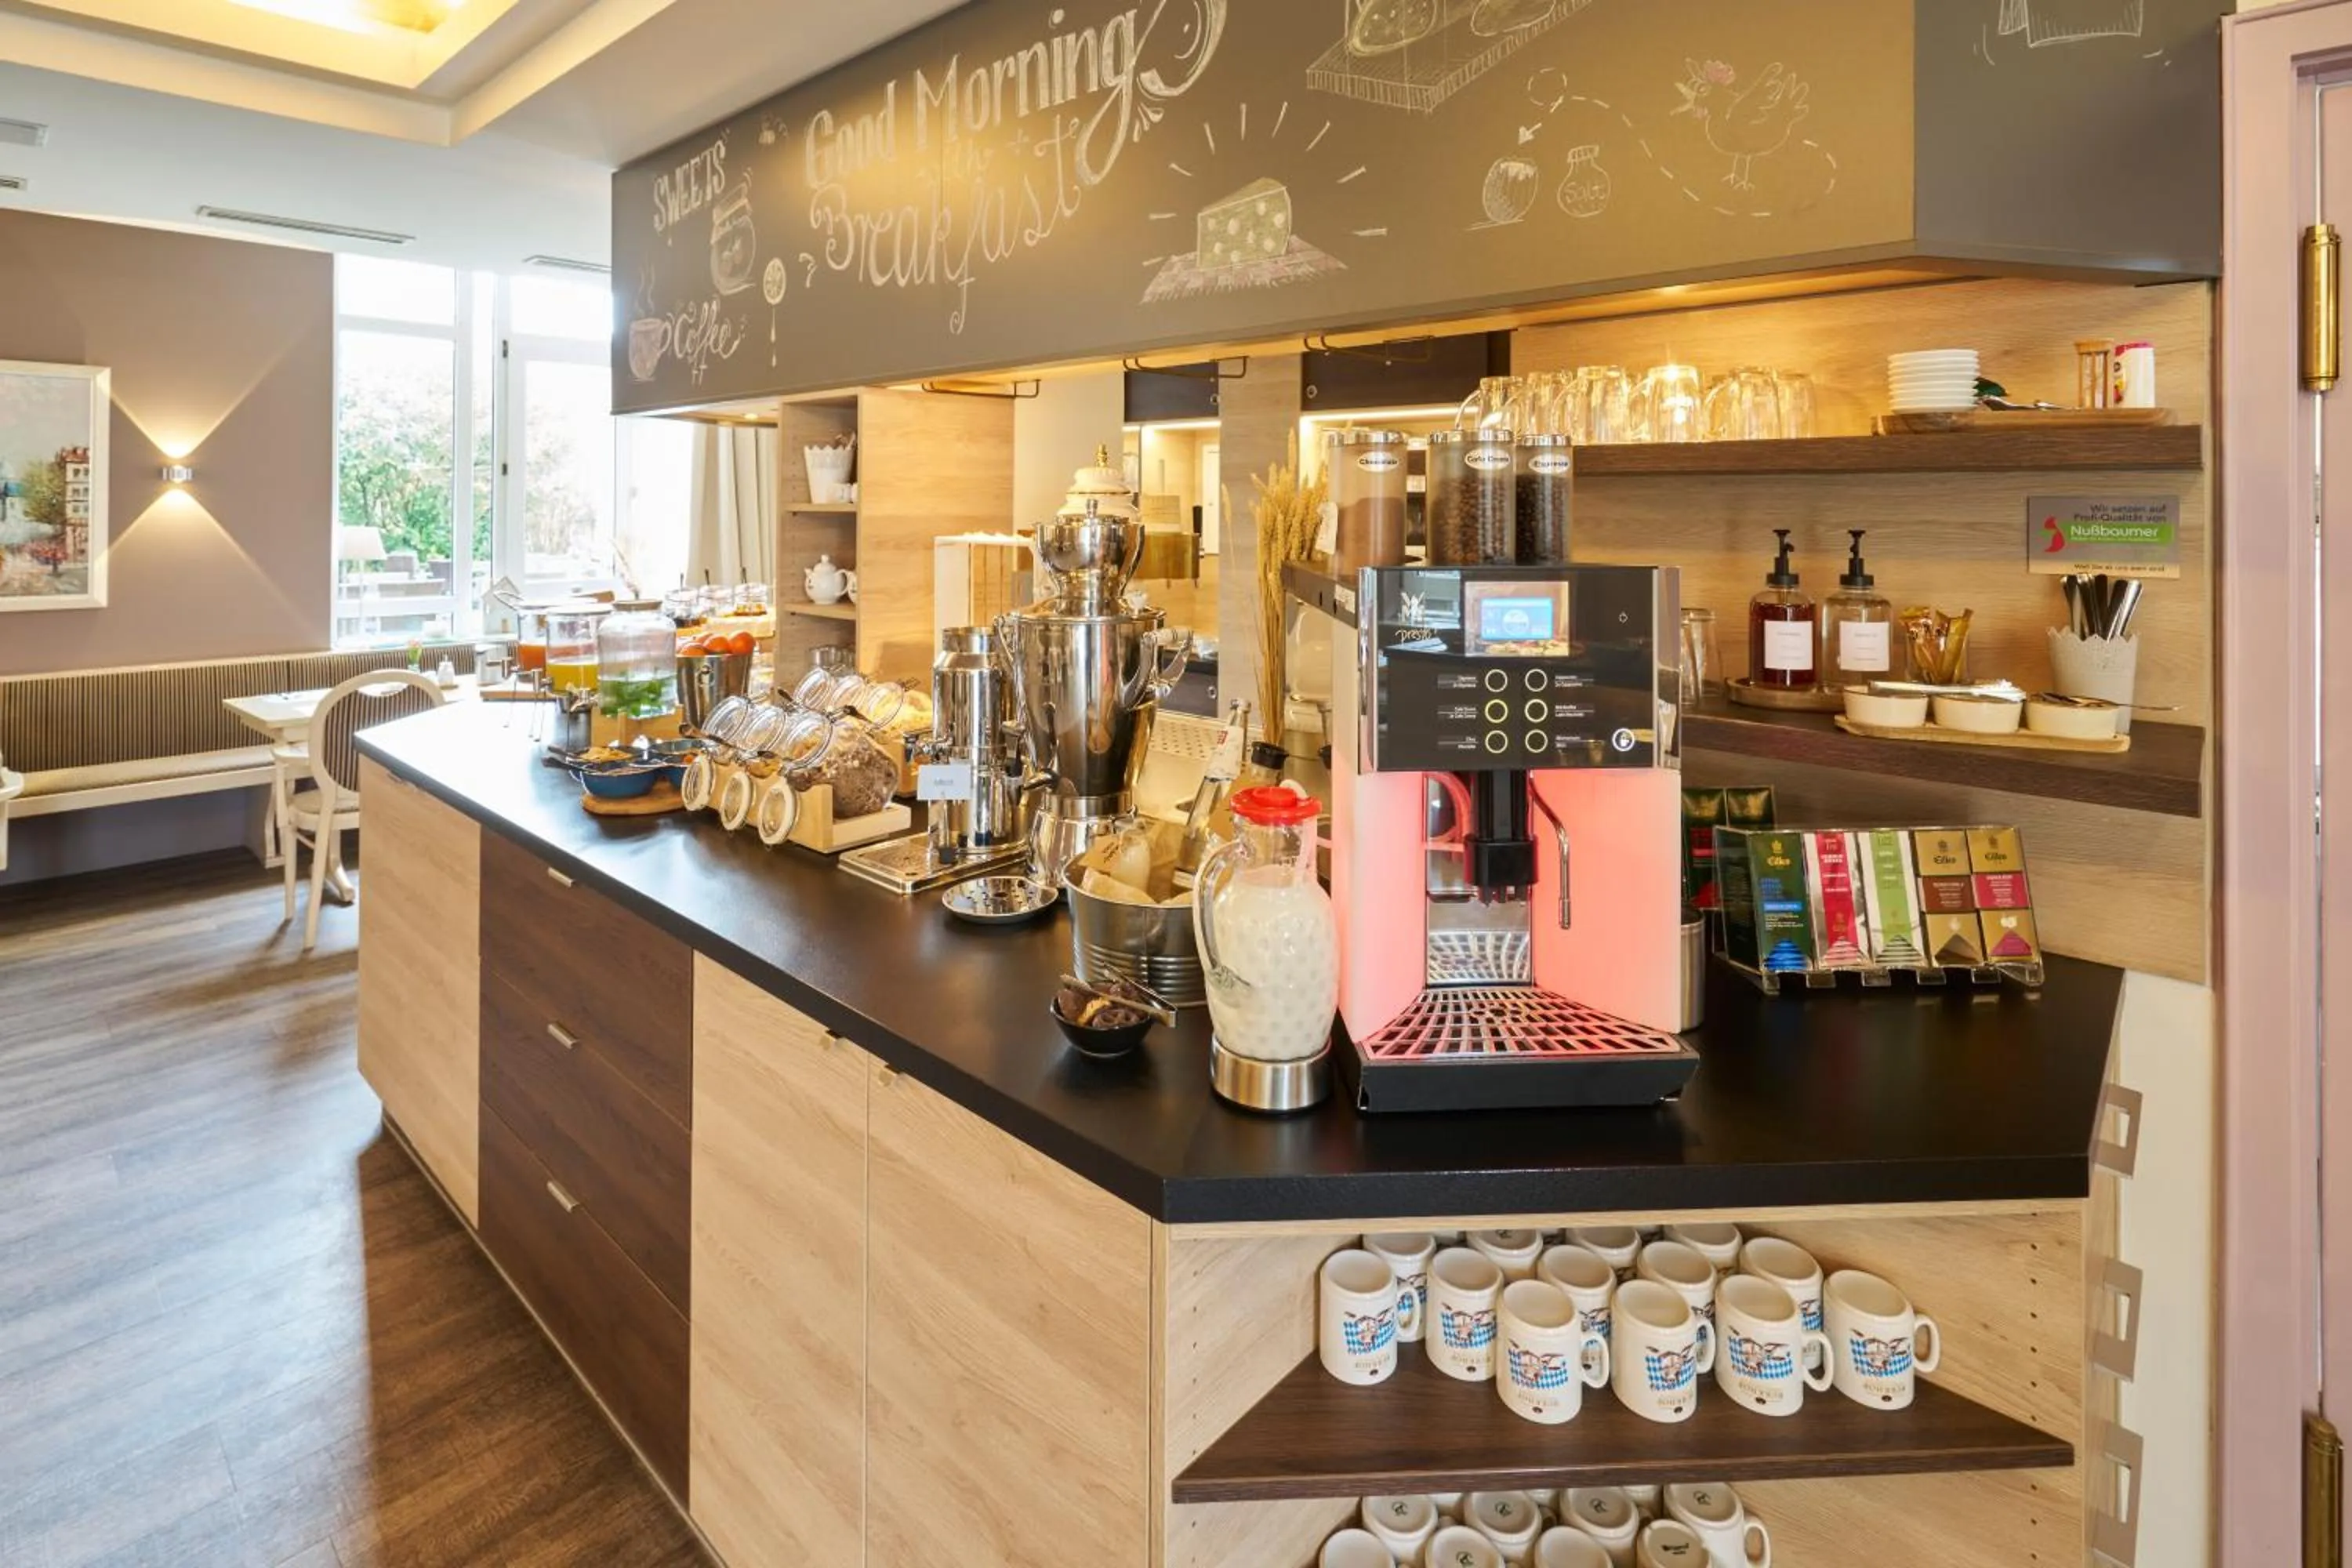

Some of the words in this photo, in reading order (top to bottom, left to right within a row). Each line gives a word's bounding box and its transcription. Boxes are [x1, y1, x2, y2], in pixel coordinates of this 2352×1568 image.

[805, 81, 895, 189] Good
[916, 8, 1156, 186] Morning
[652, 140, 727, 233] SWEETS
[810, 114, 1082, 335] Breakfast
[671, 300, 742, 387] Coffee
[2070, 524, 2159, 538] Nußbaumer
